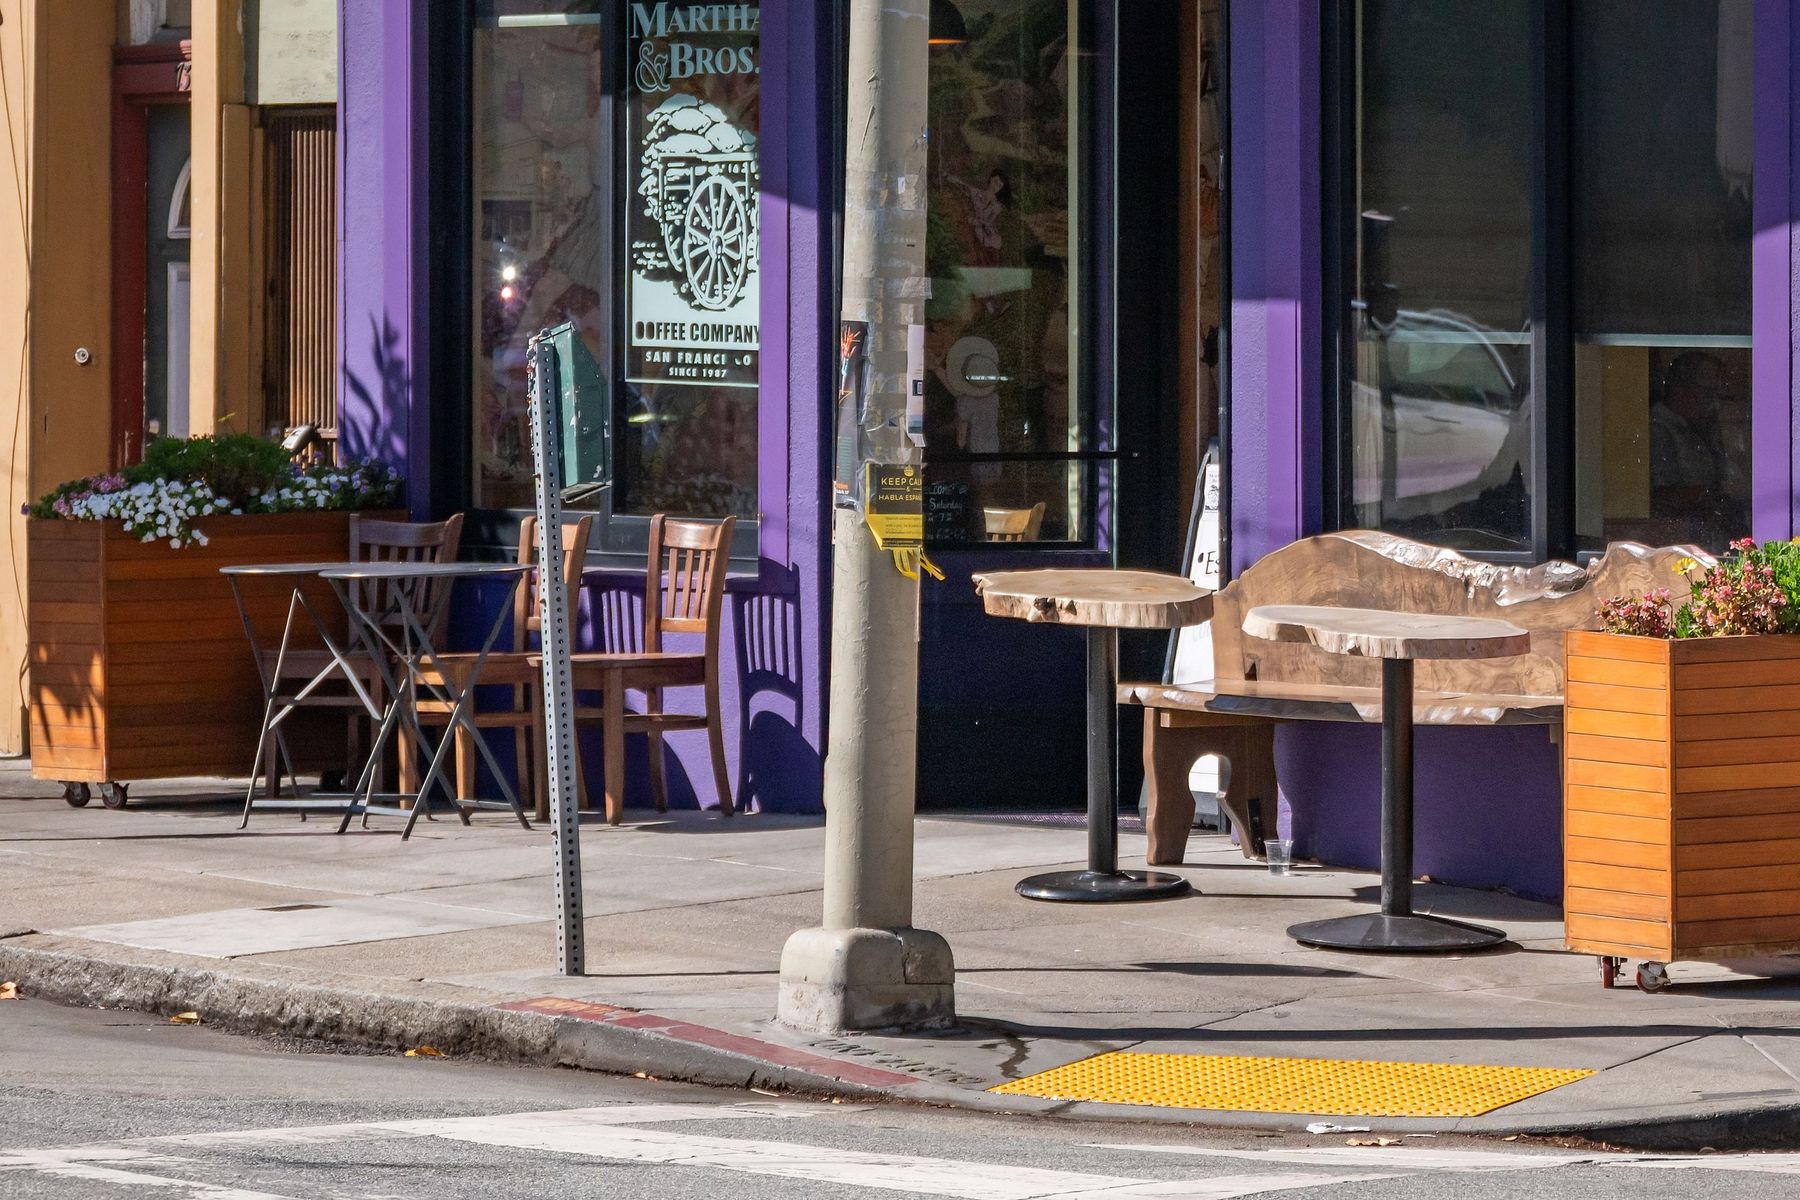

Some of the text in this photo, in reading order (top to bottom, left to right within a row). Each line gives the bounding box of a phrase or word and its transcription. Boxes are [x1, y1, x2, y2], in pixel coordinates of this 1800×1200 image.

[645, 351, 752, 366] SAN FRANCIO
[669, 367, 728, 378] SINCE 1987
[881, 477, 907, 486] KEEP
